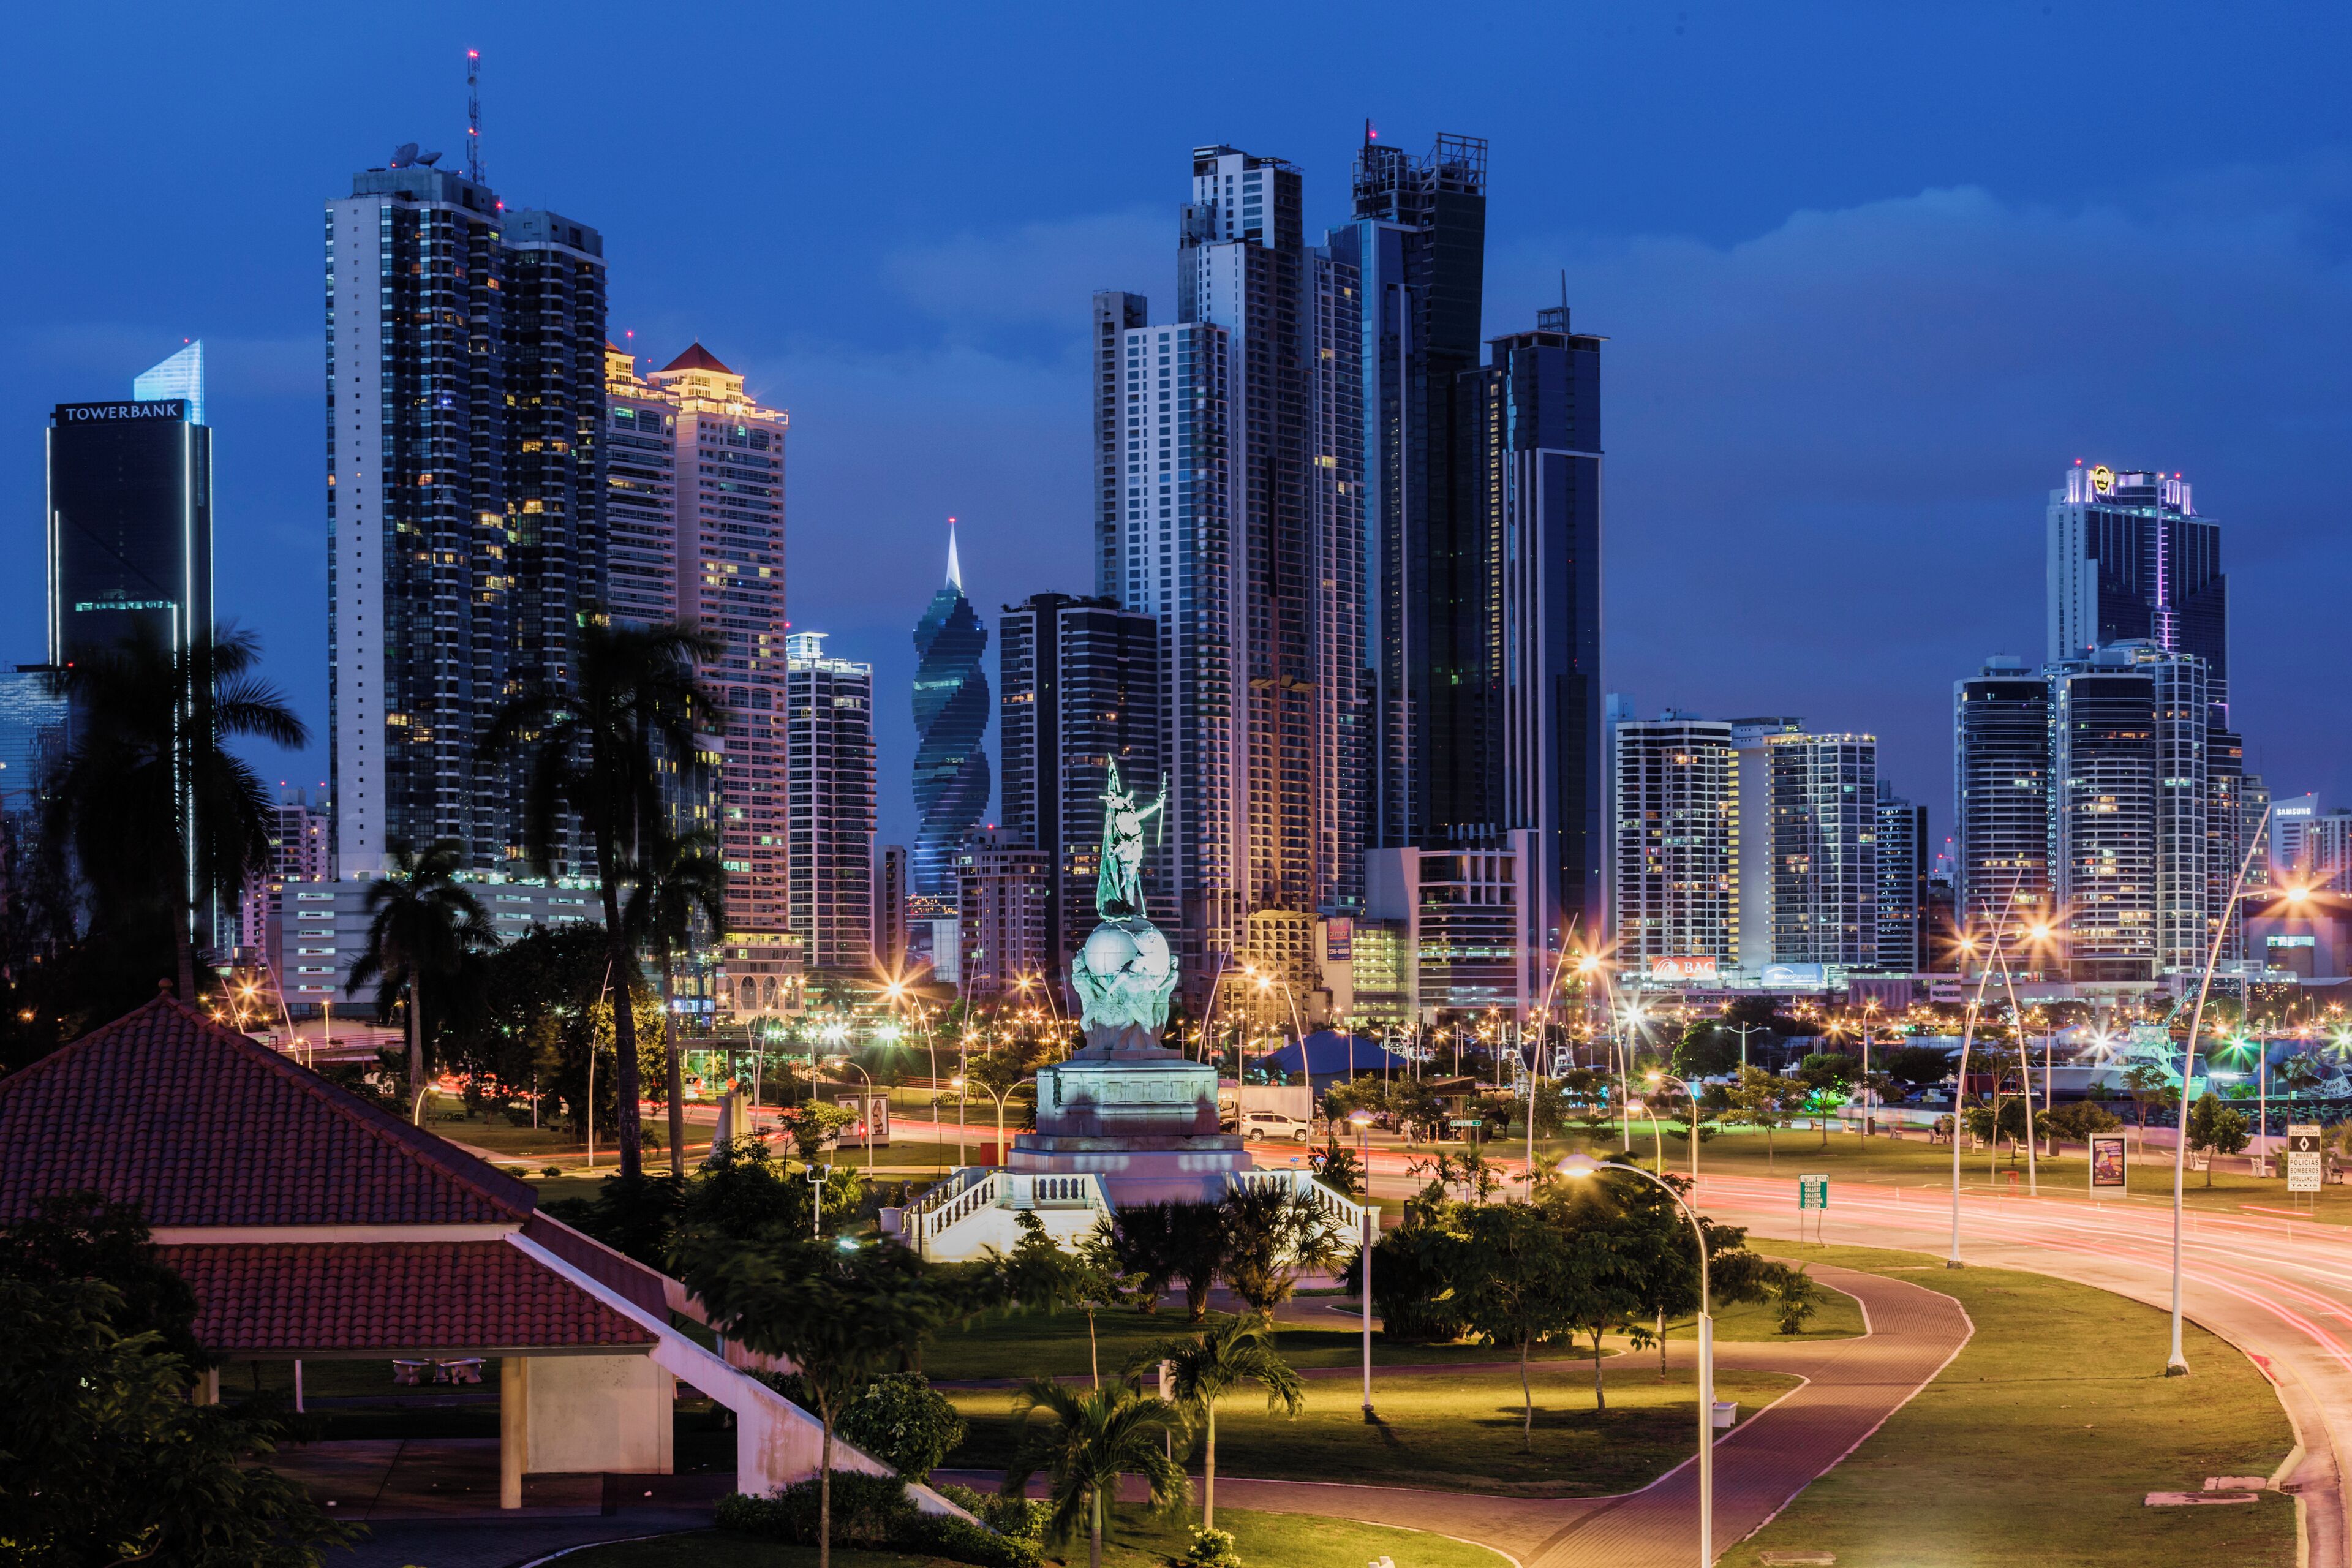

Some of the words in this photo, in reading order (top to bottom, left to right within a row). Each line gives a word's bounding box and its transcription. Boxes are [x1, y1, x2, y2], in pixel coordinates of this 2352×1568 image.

[66, 404, 178, 421] TOWERBANK
[2277, 807, 2311, 816] SAMSUNG
[1684, 962, 1714, 973] BAC
